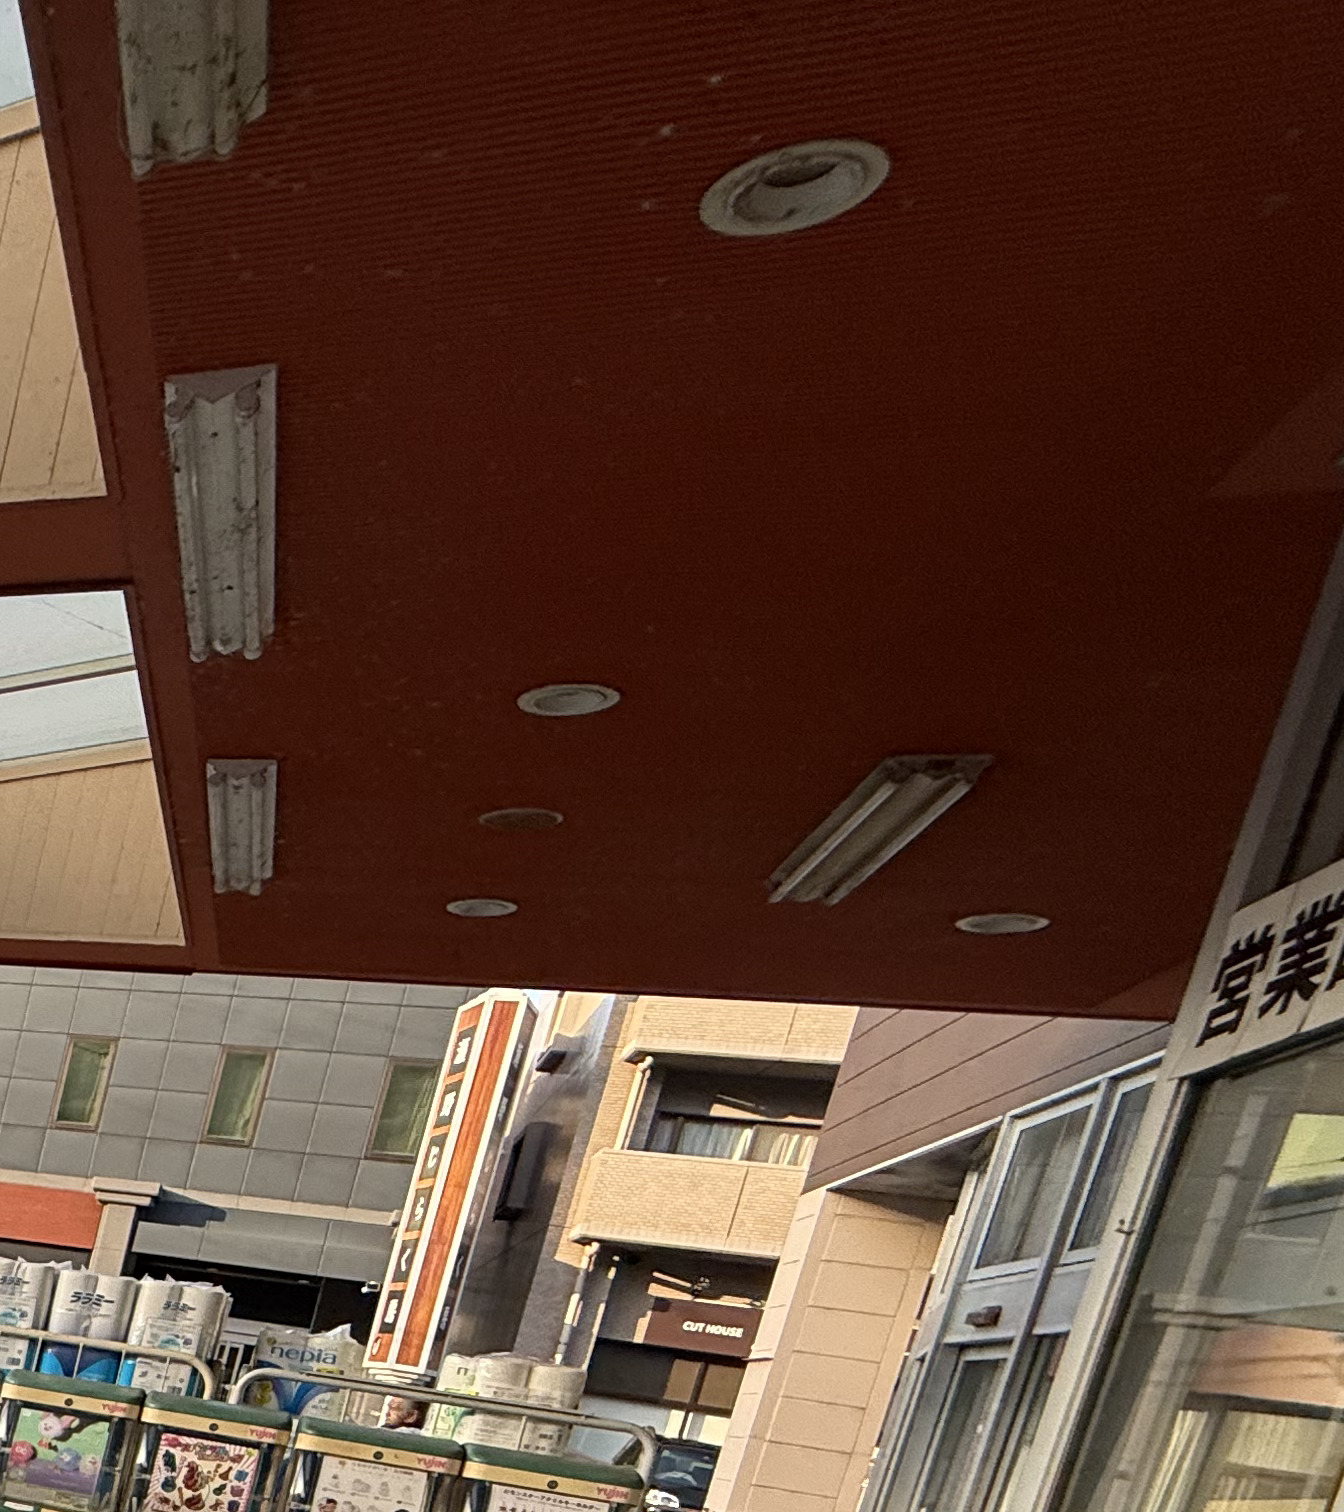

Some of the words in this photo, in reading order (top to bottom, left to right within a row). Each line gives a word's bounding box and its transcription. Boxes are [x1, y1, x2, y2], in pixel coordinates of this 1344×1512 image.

[1195, 888, 1344, 1048] 営業
[682, 1320, 706, 1333] CUT
[705, 1324, 744, 1338] HOUSE
[270, 1345, 337, 1365] nepia
